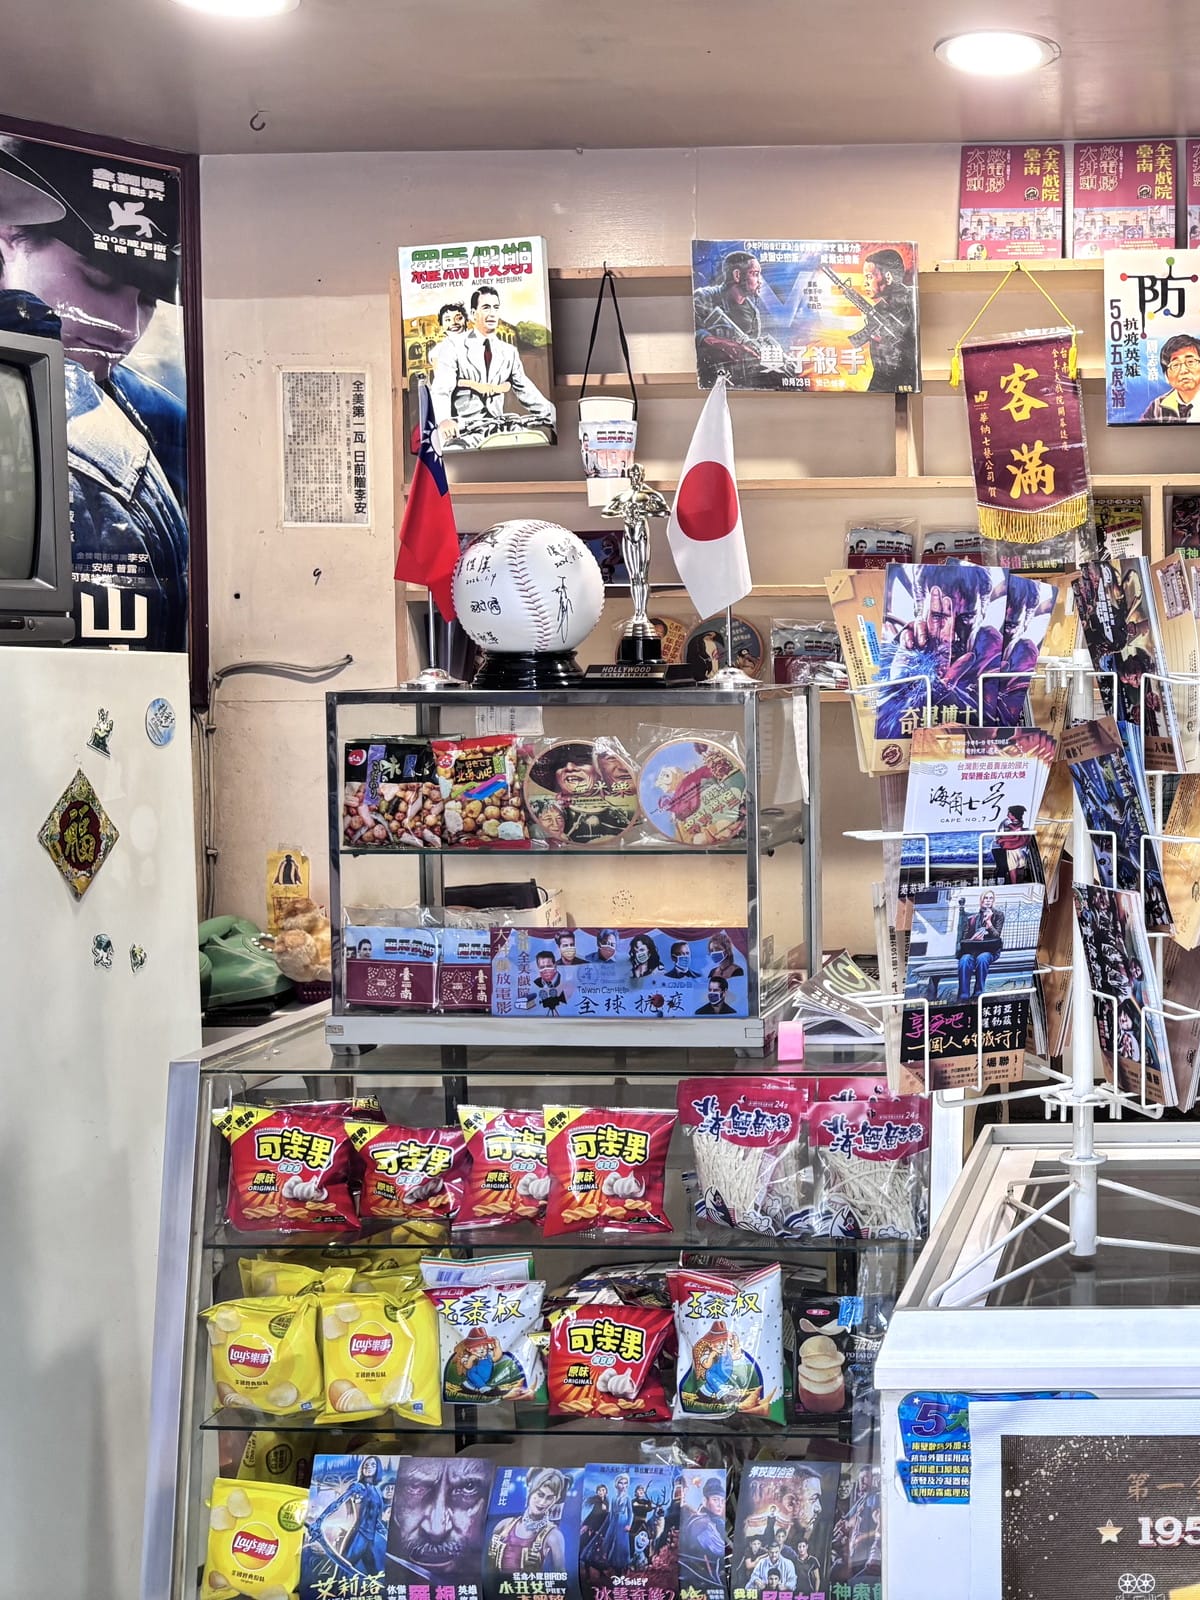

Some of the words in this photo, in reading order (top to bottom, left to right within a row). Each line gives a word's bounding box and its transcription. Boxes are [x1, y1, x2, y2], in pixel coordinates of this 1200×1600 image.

[1024, 148, 1040, 176] 臺南
[1042, 147, 1060, 202] 全美戲院
[1136, 145, 1153, 174] 臺南
[1154, 144, 1173, 200] 全美戲院
[760, 345, 866, 375] 雙子殺手
[1123, 318, 1141, 378] 抗疫英雄
[352, 380, 366, 444] 全美第一瓦
[1000, 363, 1055, 498] 客滿
[353, 450, 367, 514] 日前贈李安
[63, 803, 97, 864] 福
[575, 992, 685, 1015] 全球抗疫
[563, 1377, 594, 1386] ORIGINAL
[310, 1571, 386, 1599] 艾莉塔
[544, 1573, 568, 1581] BIRDS
